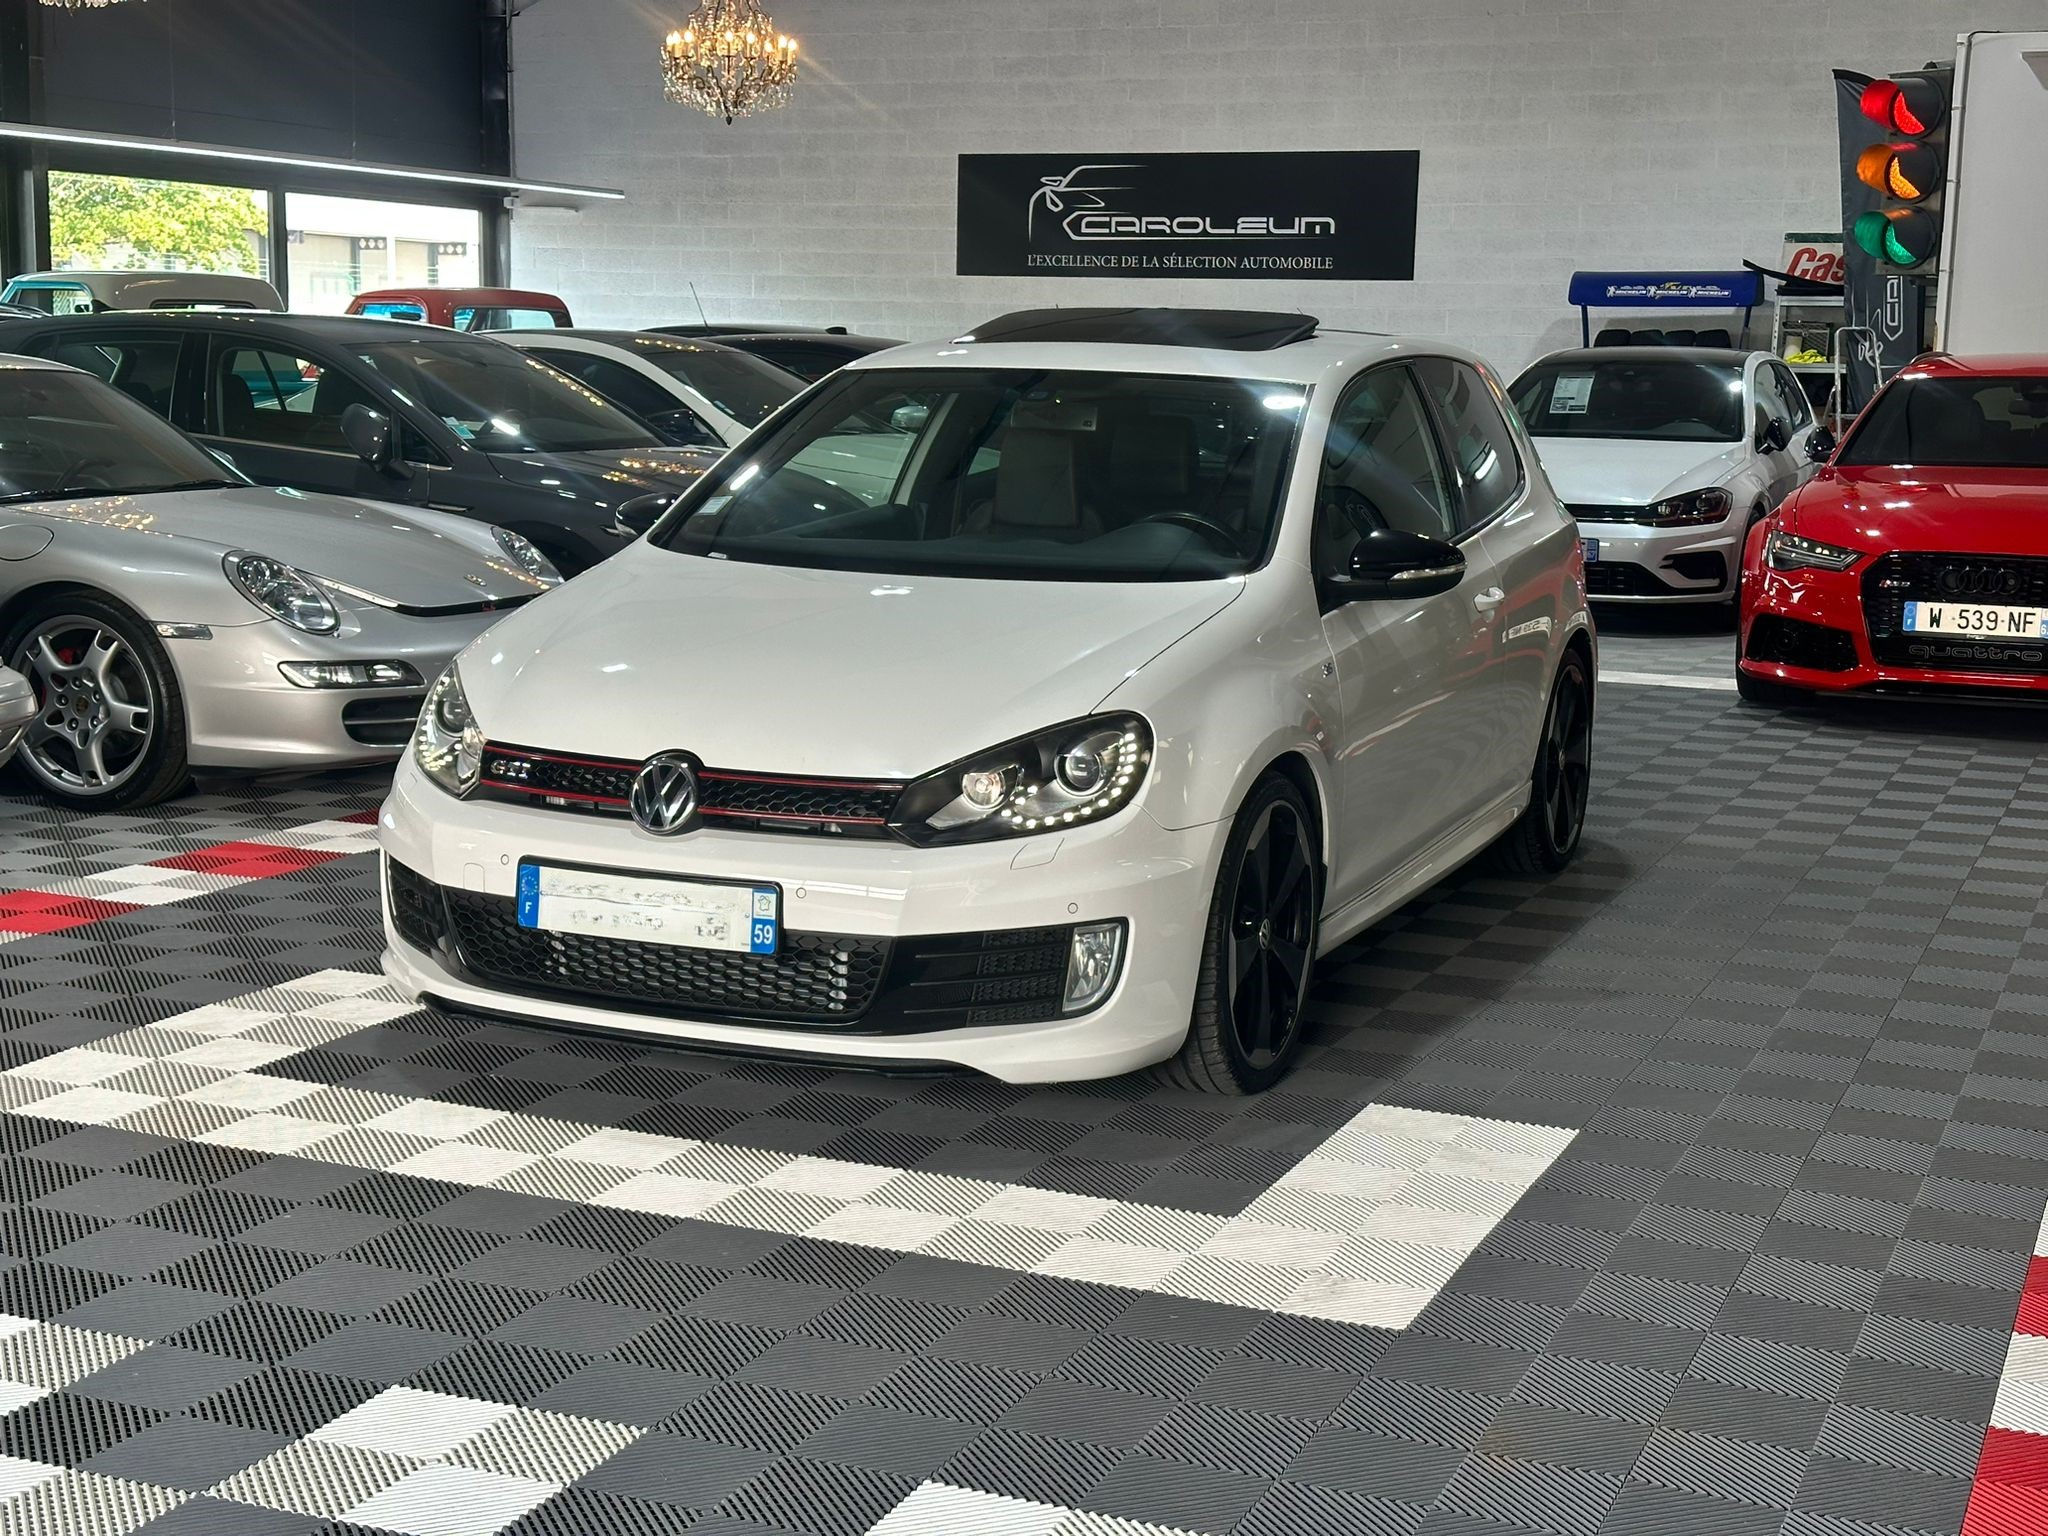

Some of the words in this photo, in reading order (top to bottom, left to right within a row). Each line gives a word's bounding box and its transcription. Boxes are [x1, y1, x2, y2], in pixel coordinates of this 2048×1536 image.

[1081, 216, 1336, 234] CAROLEUM
[1027, 254, 1118, 268] L'EXCELLENCE
[1121, 255, 1140, 268] DE
[1142, 255, 1160, 268] LA
[1162, 252, 1237, 268] SÉLECTION
[1240, 256, 1334, 270] AUTOMOBILE
[1909, 645, 2042, 661] quattro
[490, 760, 531, 779] GTI
[524, 901, 532, 914] F
[753, 924, 773, 945] 59
